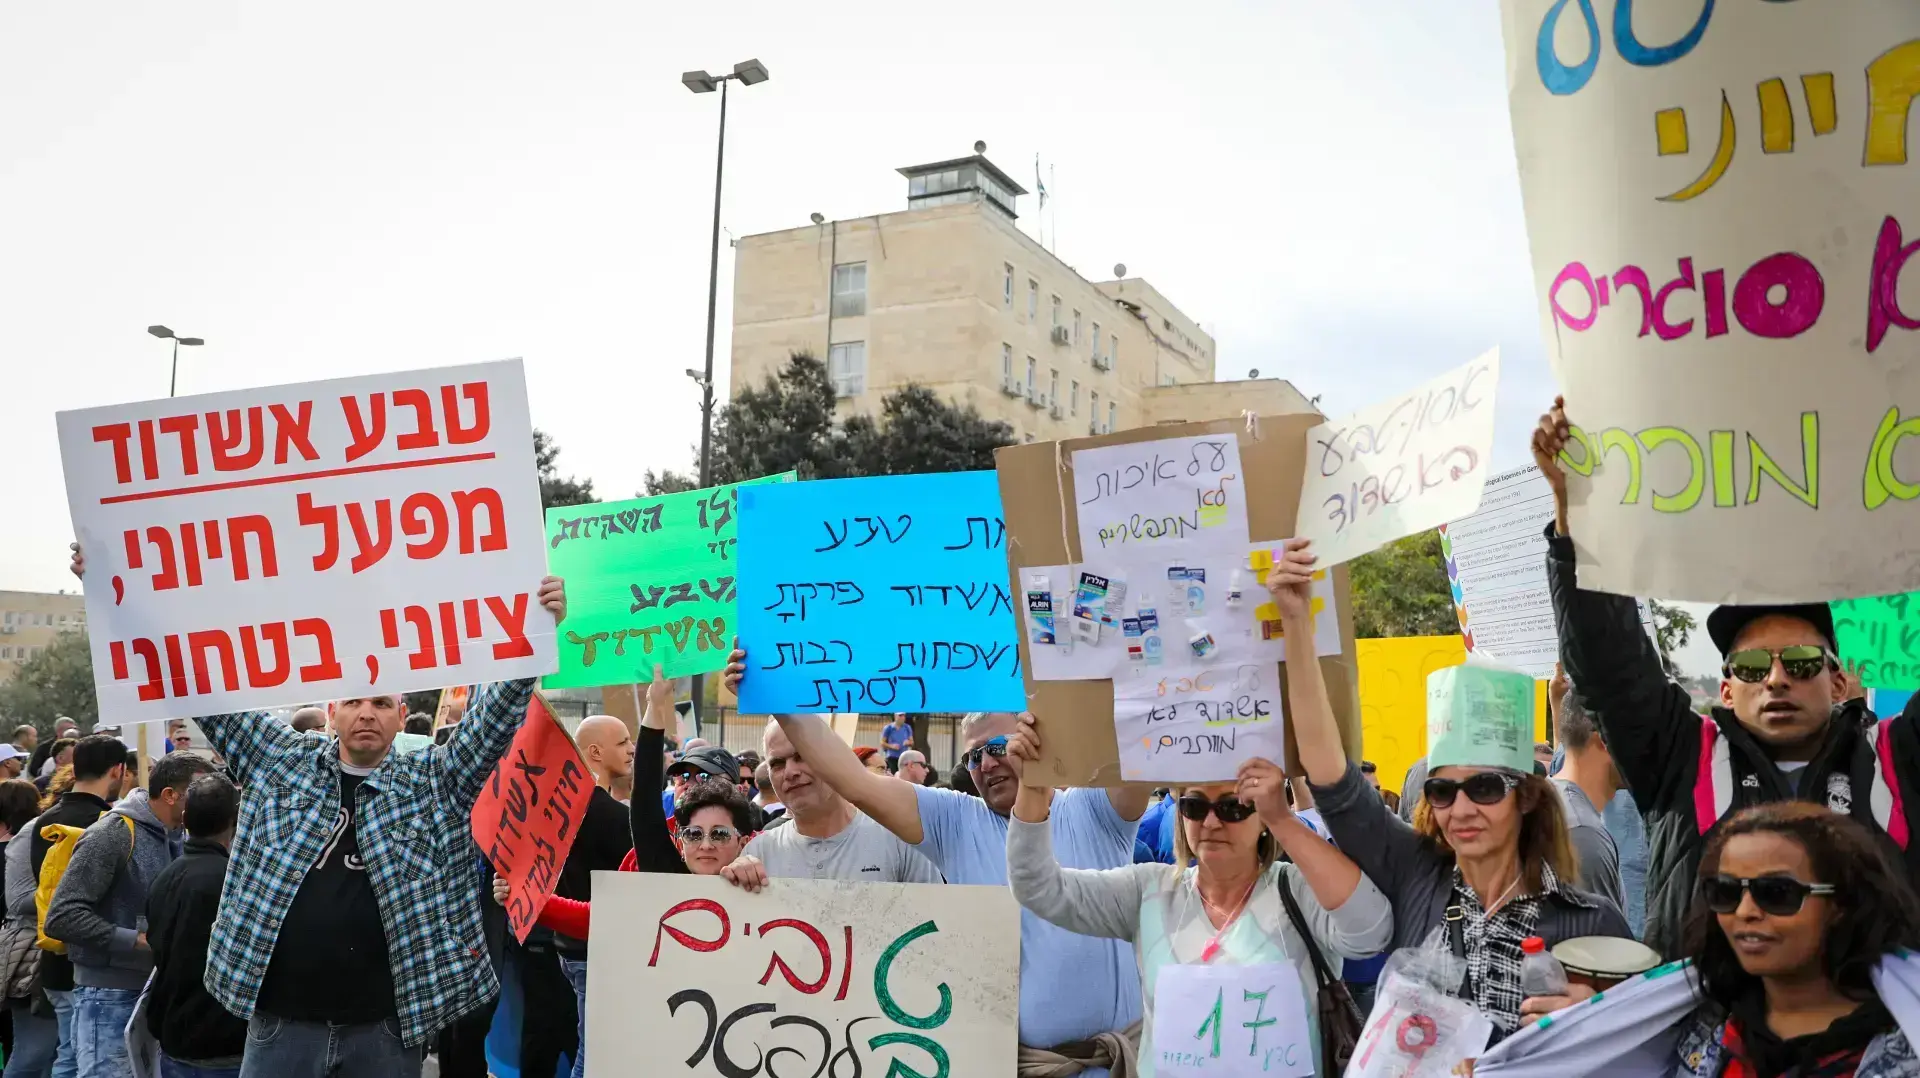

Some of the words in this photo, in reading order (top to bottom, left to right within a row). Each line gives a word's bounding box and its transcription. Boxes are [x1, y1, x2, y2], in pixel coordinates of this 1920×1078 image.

[1548, 251, 1825, 358] סוגרים
[92, 399, 320, 485] אשדוד
[339, 381, 491, 463] טבע
[1187, 441, 1228, 476] על
[1556, 410, 1819, 513] מוכרים
[1082, 454, 1177, 505] איכות
[1197, 473, 1236, 508] לא
[1322, 445, 1479, 534] באשדוד
[111, 514, 279, 606] חיוני,
[297, 487, 509, 574] מפעל
[815, 514, 912, 552] טבע
[1098, 509, 1198, 549] מתפשרים
[630, 575, 737, 615] טבע
[890, 581, 1013, 617] אשדוד
[109, 617, 342, 702] בטחוני
[365, 593, 535, 686] ציוני,
[565, 615, 726, 668] אשדוד
[762, 639, 853, 670] רבות
[1147, 704, 1178, 725] לא
[1195, 695, 1271, 723] אשדוד
[490, 749, 546, 874] אשדוד
[542, 759, 584, 842] חיוני
[509, 832, 557, 931] למדינה
[647, 898, 953, 1029] טובים
[1193, 984, 1278, 1059] 17
